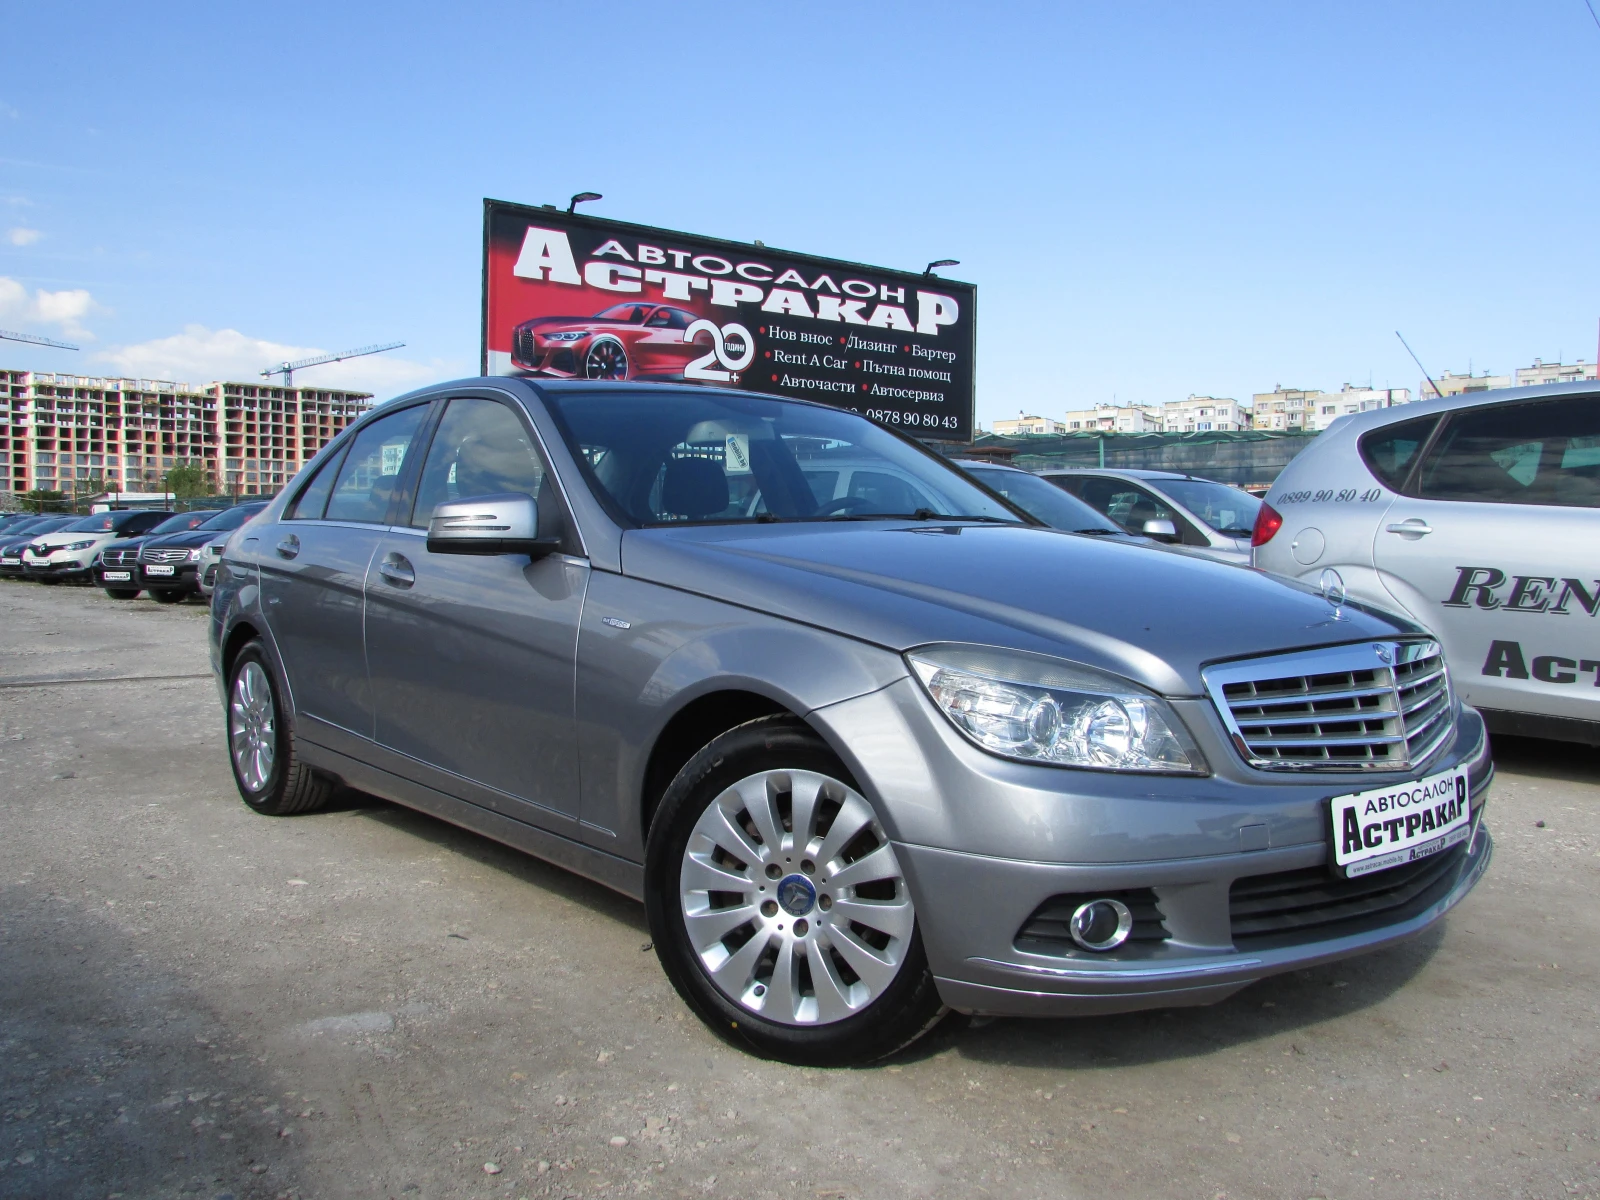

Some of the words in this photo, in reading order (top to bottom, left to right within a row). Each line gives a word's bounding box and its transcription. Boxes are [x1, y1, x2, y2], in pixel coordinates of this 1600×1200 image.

[592, 240, 905, 303] АВТОСАЛОН
[724, 342, 745, 353] ГОДИНИ
[769, 325, 797, 341] Нов
[799, 332, 833, 346] внос
[846, 336, 897, 353] Лизинг
[912, 344, 956, 363] Бартер
[774, 349, 807, 365] Rent
[809, 354, 820, 367] A
[823, 355, 848, 369] Car
[863, 359, 905, 377] Пътна
[908, 366, 951, 383] помощ
[780, 373, 856, 393] Авточасти
[870, 383, 944, 402] Автосервиз
[903, 412, 920, 425] 90
[922, 413, 939, 427] 80
[941, 416, 958, 429] 43
[1276, 490, 1312, 505] 0899
[1312, 489, 1333, 503] 90
[1335, 488, 1357, 502] 80
[1359, 488, 1381, 502] 40
[1364, 776, 1454, 816] АВТОСАЛОН
